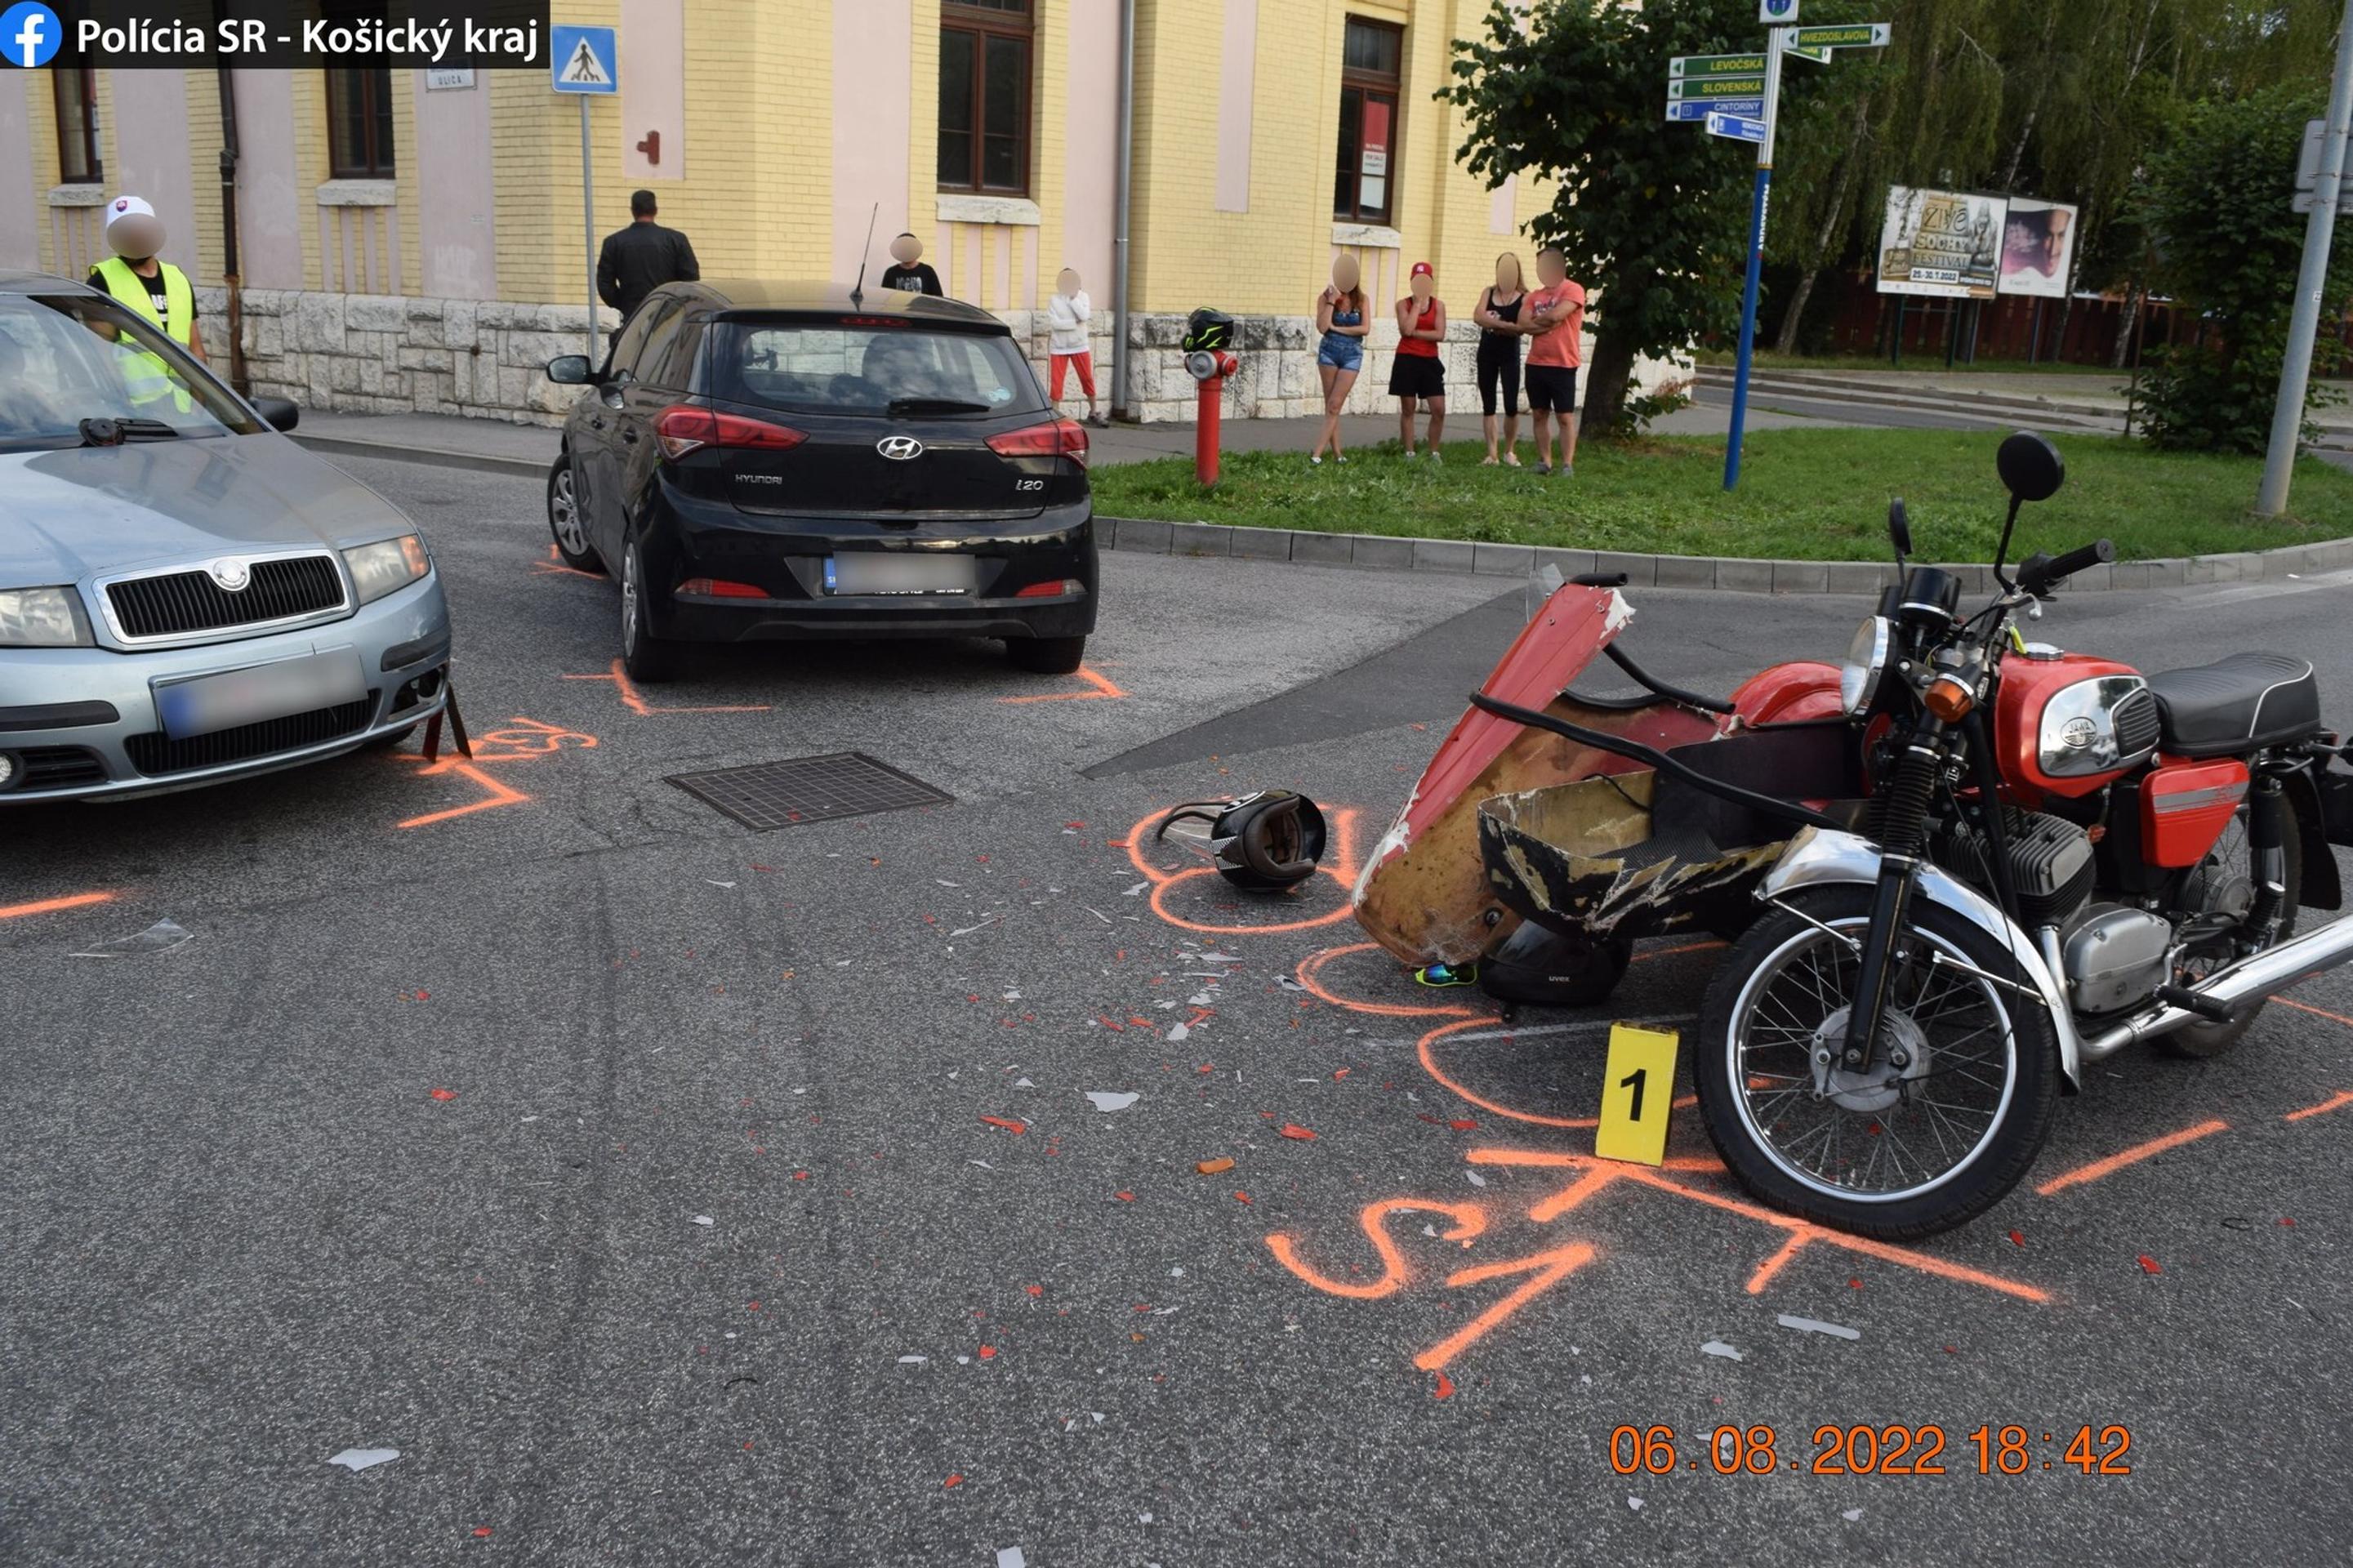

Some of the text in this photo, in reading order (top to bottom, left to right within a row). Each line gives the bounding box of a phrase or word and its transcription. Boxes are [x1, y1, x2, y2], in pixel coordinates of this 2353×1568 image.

[1799, 30, 1870, 43] HVIEZDOSLAVOVA
[1710, 57, 1764, 72] LEVOČSKÁ
[1701, 80, 1762, 94] SLOVENSKÁ
[1714, 100, 1761, 112] CINTORÍNY
[1914, 232, 1968, 252] SOCHY
[1913, 253, 1970, 270] FESTIVAL
[735, 474, 782, 485] HYUNDAI
[1015, 479, 1043, 491] i20
[1620, 1067, 1647, 1122] 1
